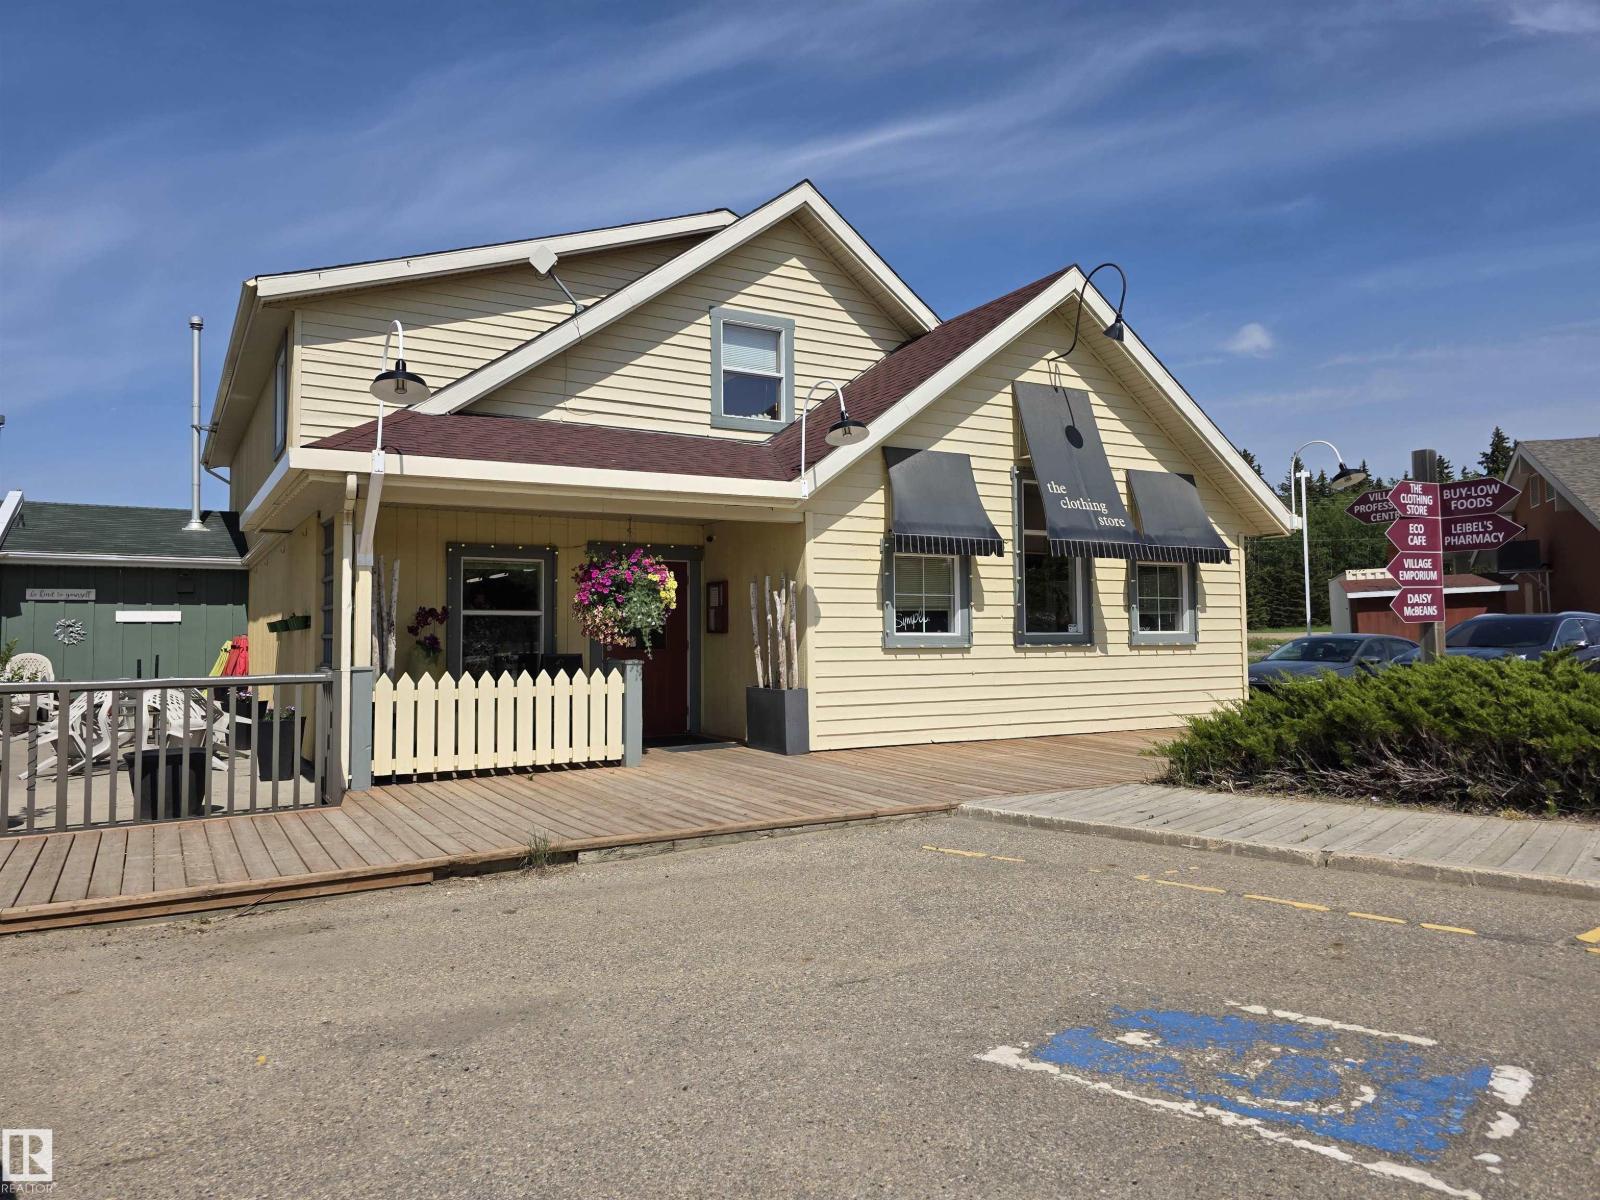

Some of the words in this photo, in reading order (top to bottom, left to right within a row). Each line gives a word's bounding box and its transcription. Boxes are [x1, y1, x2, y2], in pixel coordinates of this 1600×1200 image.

[1046, 480, 1067, 494] the
[1409, 483, 1423, 494] THE
[1443, 484, 1500, 500] BUY-LOW
[1368, 491, 1388, 502] VILL
[1400, 495, 1433, 506] CLOTHING
[1060, 496, 1108, 514] clothing
[1354, 501, 1395, 514] PROFESS
[1406, 504, 1428, 516] STORE
[1451, 497, 1493, 511] FOODS
[1097, 515, 1126, 527] store
[1370, 511, 1400, 522] CENTR
[1408, 523, 1425, 534] ECO
[1451, 521, 1493, 534] LEIBEL'S
[1407, 535, 1427, 546] CAFE
[1444, 532, 1505, 546] PHARMACY
[1403, 558, 1432, 569] VILLAGE
[1399, 570, 1438, 581] EMPORIUM
[1407, 593, 1432, 604] DAISY
[1403, 605, 1438, 617] McBEANS
